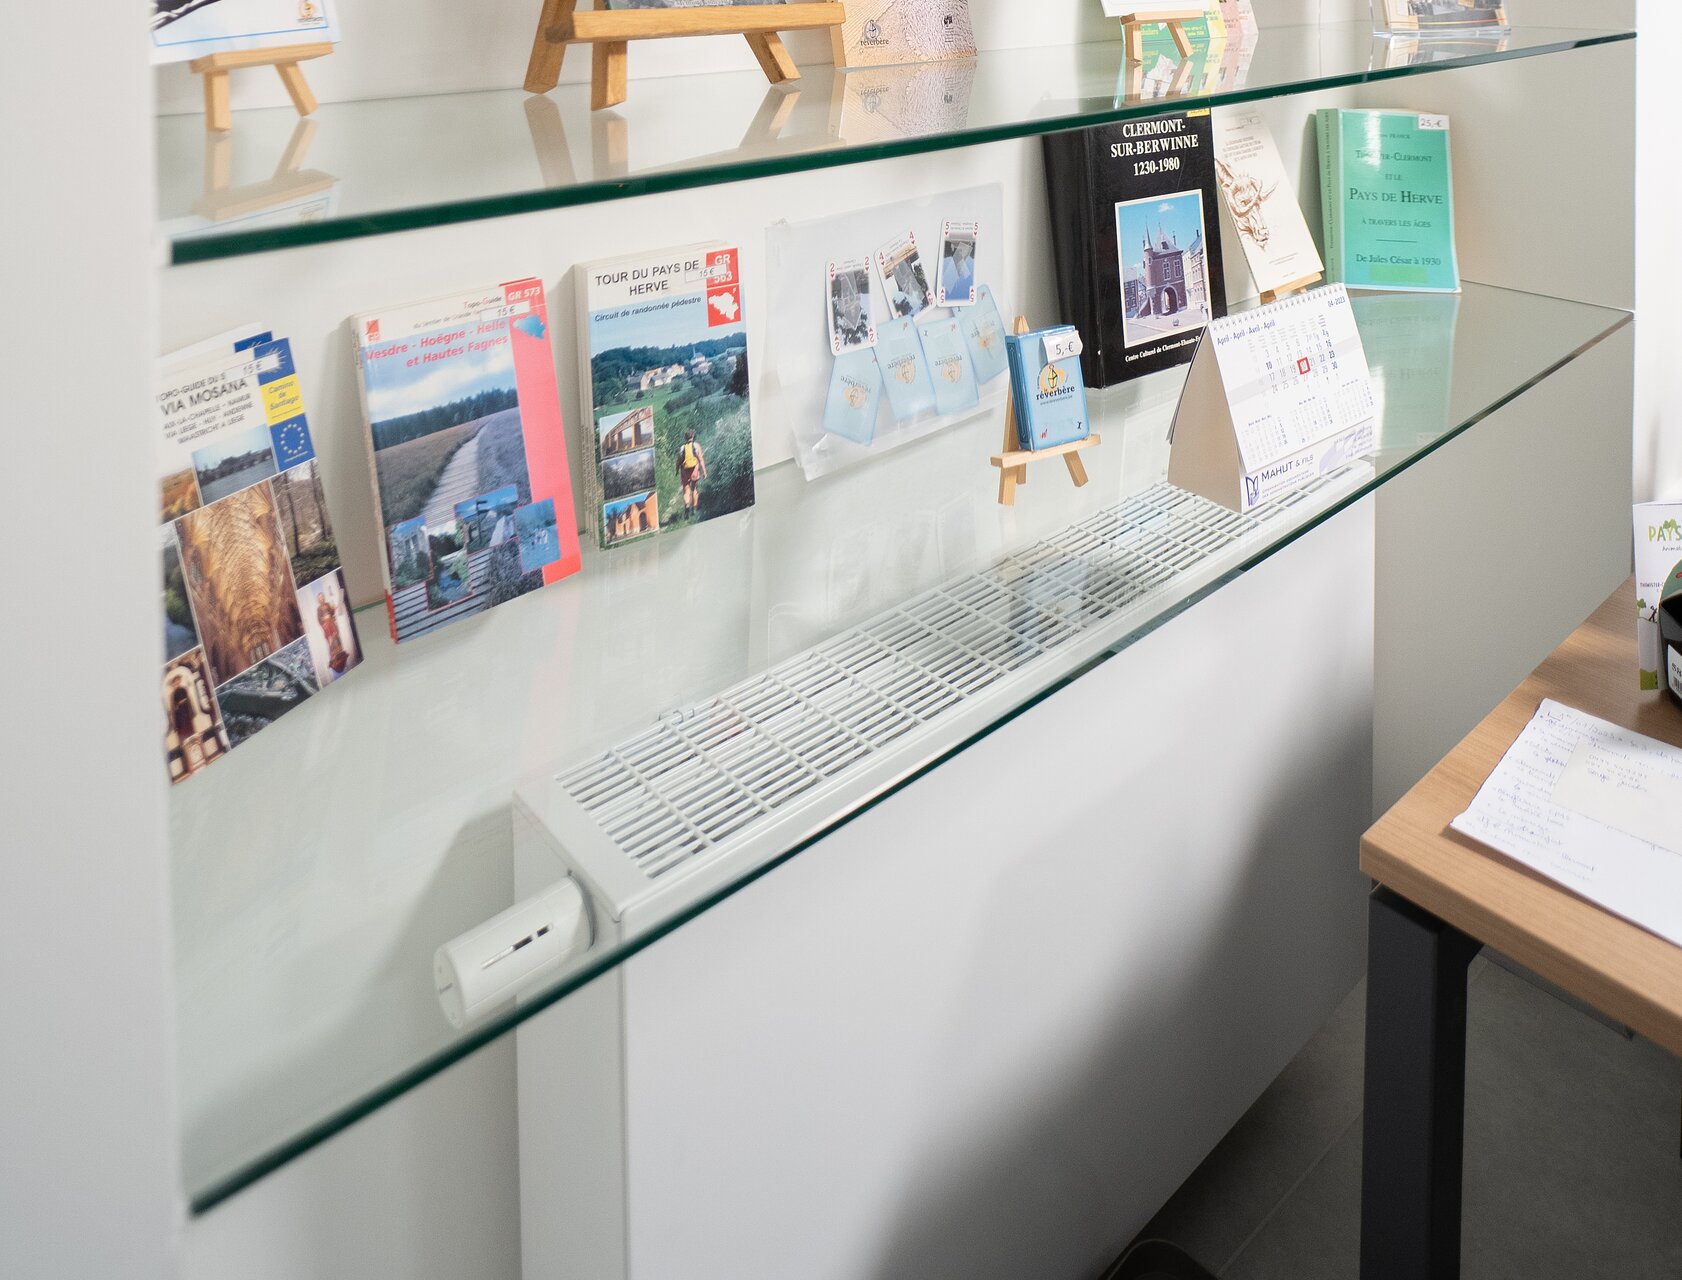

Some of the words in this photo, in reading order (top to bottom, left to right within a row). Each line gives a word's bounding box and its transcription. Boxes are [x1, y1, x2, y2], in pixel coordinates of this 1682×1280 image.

[1122, 118, 1187, 138] CLERMONT-
[1110, 134, 1199, 158] SUR-BERWINNE
[1132, 156, 1181, 177] 1230-1980
[714, 253, 732, 266] GR
[595, 271, 629, 287] TOUR
[632, 268, 649, 281] DU
[652, 263, 681, 278] PAYS
[684, 260, 700, 271] DE
[629, 278, 669, 297] HERVE
[594, 310, 620, 323] Circuit
[621, 308, 631, 318] de
[631, 300, 670, 317] randonnée
[671, 295, 702, 310] pédestre
[420, 330, 466, 348] Hoëgne
[1055, 341, 1075, 357] 5,-€
[406, 356, 420, 368] et
[423, 345, 464, 364] Hautes
[467, 335, 509, 353] Fagnes
[161, 399, 187, 417] VIA
[189, 378, 249, 408] MOSANA
[1036, 385, 1076, 401] réverbère
[1261, 461, 1294, 483] MAHUT
